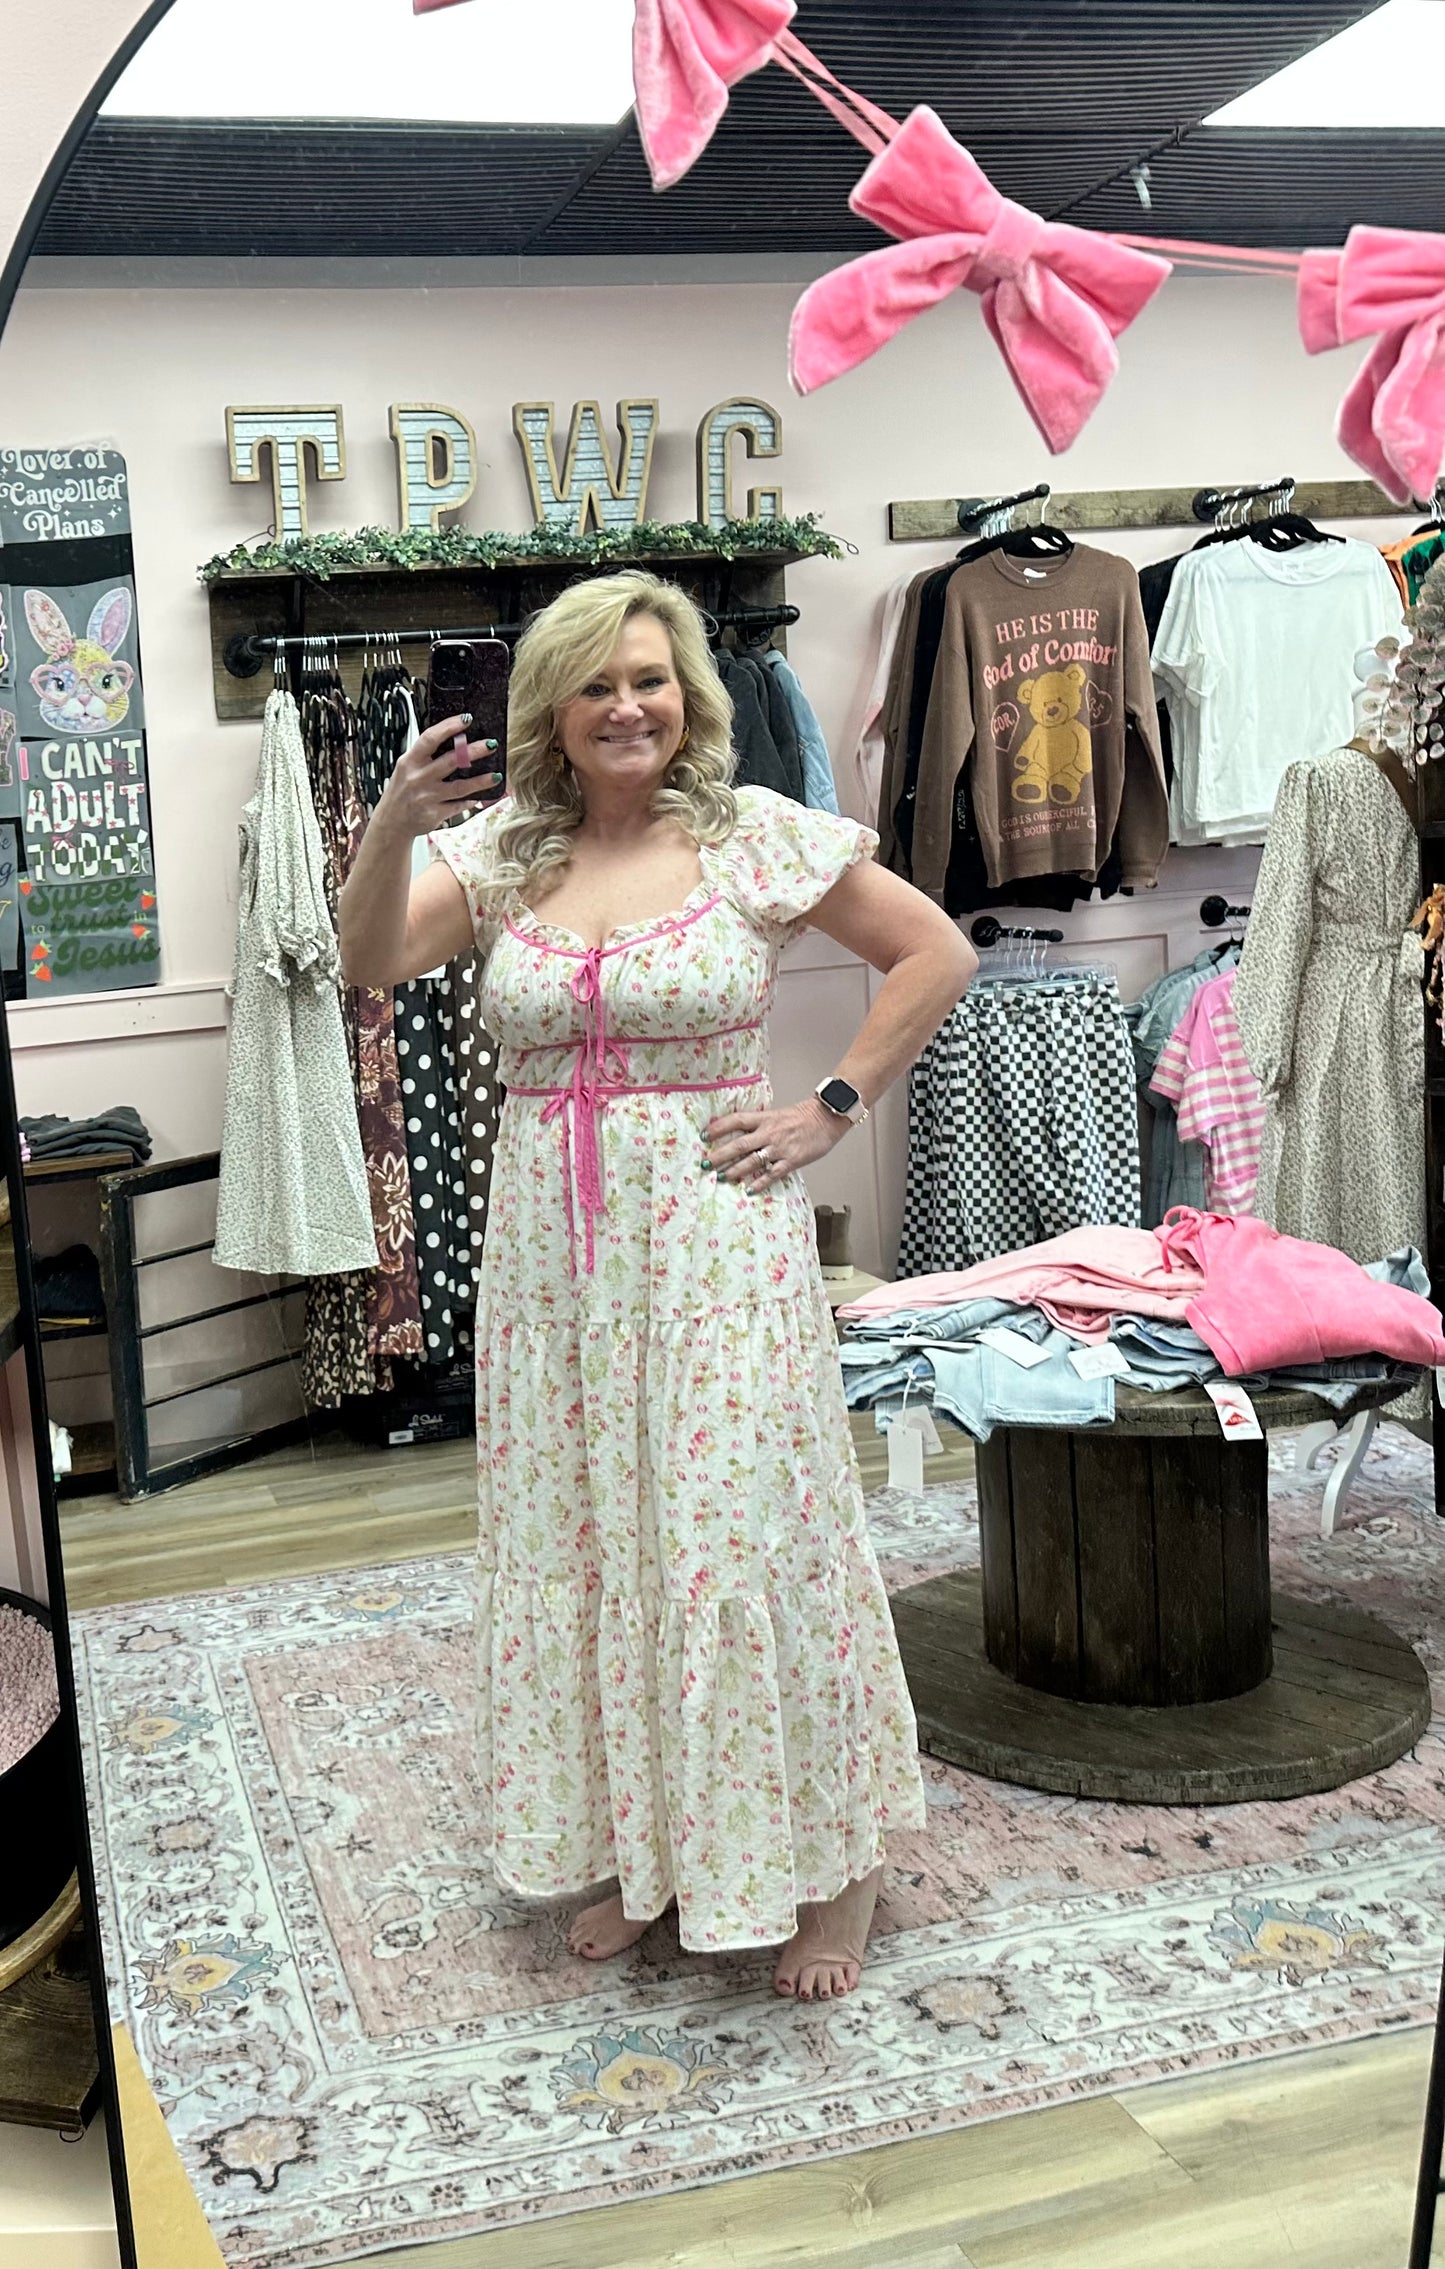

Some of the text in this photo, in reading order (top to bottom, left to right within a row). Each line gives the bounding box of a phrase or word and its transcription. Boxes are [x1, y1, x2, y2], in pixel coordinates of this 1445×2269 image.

[2, 441, 111, 480] Lover of
[0, 473, 126, 512] Cancelled
[23, 510, 105, 541] Plans
[995, 608, 1099, 644] HE IS THE
[1018, 643, 1040, 673] of
[41, 737, 142, 780] CAN'T
[26, 781, 145, 834] ADULT
[27, 829, 150, 880] TODAY
[26, 877, 141, 917] Sweet
[31, 924, 46, 935] to
[133, 909, 148, 922] in
[52, 936, 161, 977] Jesus
